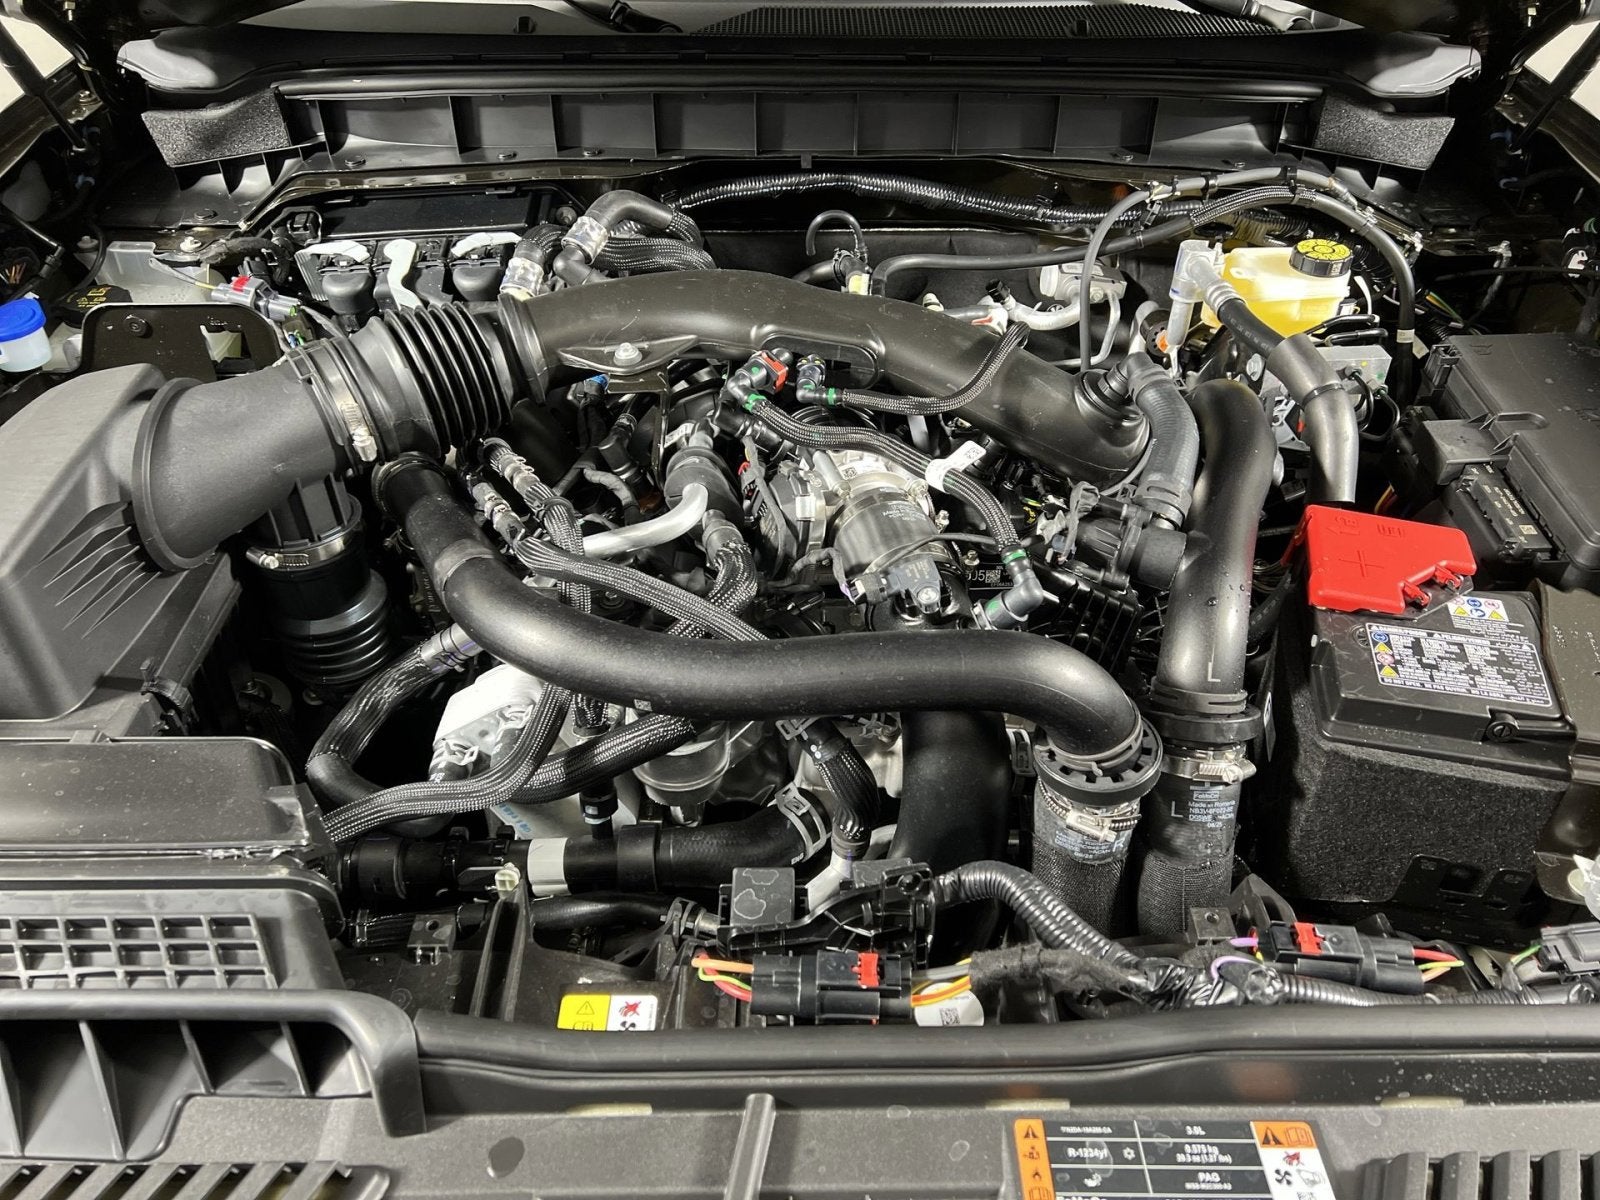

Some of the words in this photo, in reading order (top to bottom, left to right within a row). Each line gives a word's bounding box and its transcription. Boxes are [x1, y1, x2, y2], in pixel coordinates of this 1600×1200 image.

[1208, 662, 1221, 682] L
[1171, 801, 1183, 818] L
[1185, 1125, 1206, 1136] 3.0L
[1066, 1147, 1108, 1160] R-1234yf
